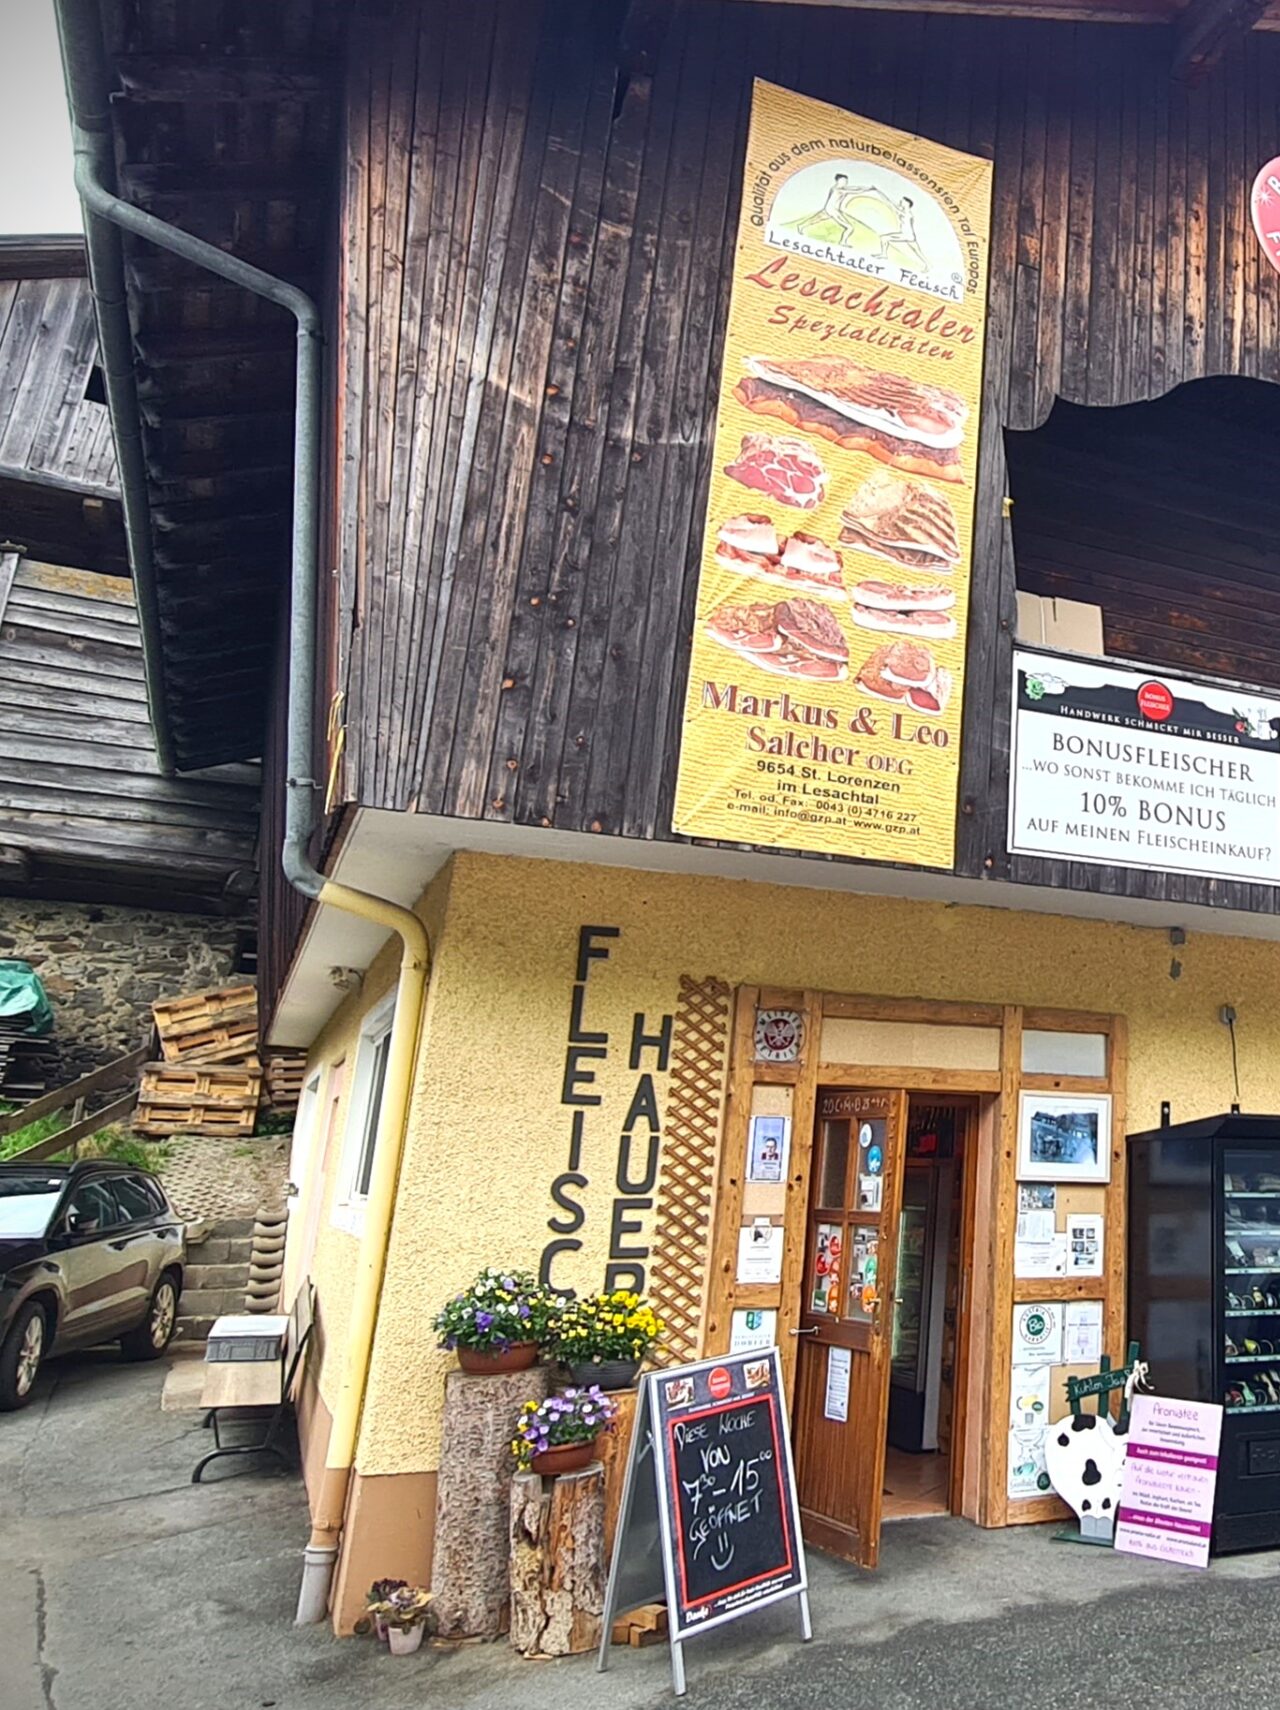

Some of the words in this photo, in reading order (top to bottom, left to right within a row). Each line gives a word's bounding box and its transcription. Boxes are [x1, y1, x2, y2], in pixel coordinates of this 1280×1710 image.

[768, 152, 791, 173] aus
[791, 138, 825, 157] dem
[751, 170, 772, 227] Qualität
[958, 216, 976, 238] Tal
[768, 230, 885, 275] Lesachtaler
[900, 267, 960, 300] Fleisch
[966, 241, 980, 295] Europas
[744, 255, 976, 344] Lesachtaler
[767, 303, 956, 361] Spezialitäten
[701, 680, 840, 730] Markus
[848, 706, 880, 737] &
[890, 711, 950, 748] Leo
[745, 725, 861, 767] Salcher
[865, 752, 914, 776] OEG
[1052, 732, 1254, 783] BONUSFLEISCHER
[1206, 731, 1241, 745] BESSER
[756, 759, 796, 777] 9654
[801, 766, 822, 781] St.
[827, 771, 901, 794] Lorenzen
[776, 779, 797, 794] im
[802, 782, 880, 805] Lesachtal
[1064, 763, 1111, 784] SONST
[1116, 772, 1185, 795] BEKOMME
[1190, 783, 1216, 799] ICH
[1219, 786, 1277, 809] TÄGLICH
[735, 788, 756, 801] Tel.
[816, 800, 845, 813] 0043
[1080, 791, 1128, 819] 10%
[1138, 799, 1227, 832] BONUS
[853, 819, 921, 837] www.gzp.at
[1026, 817, 1059, 834] AUF
[1065, 821, 1131, 843] MEINEN
